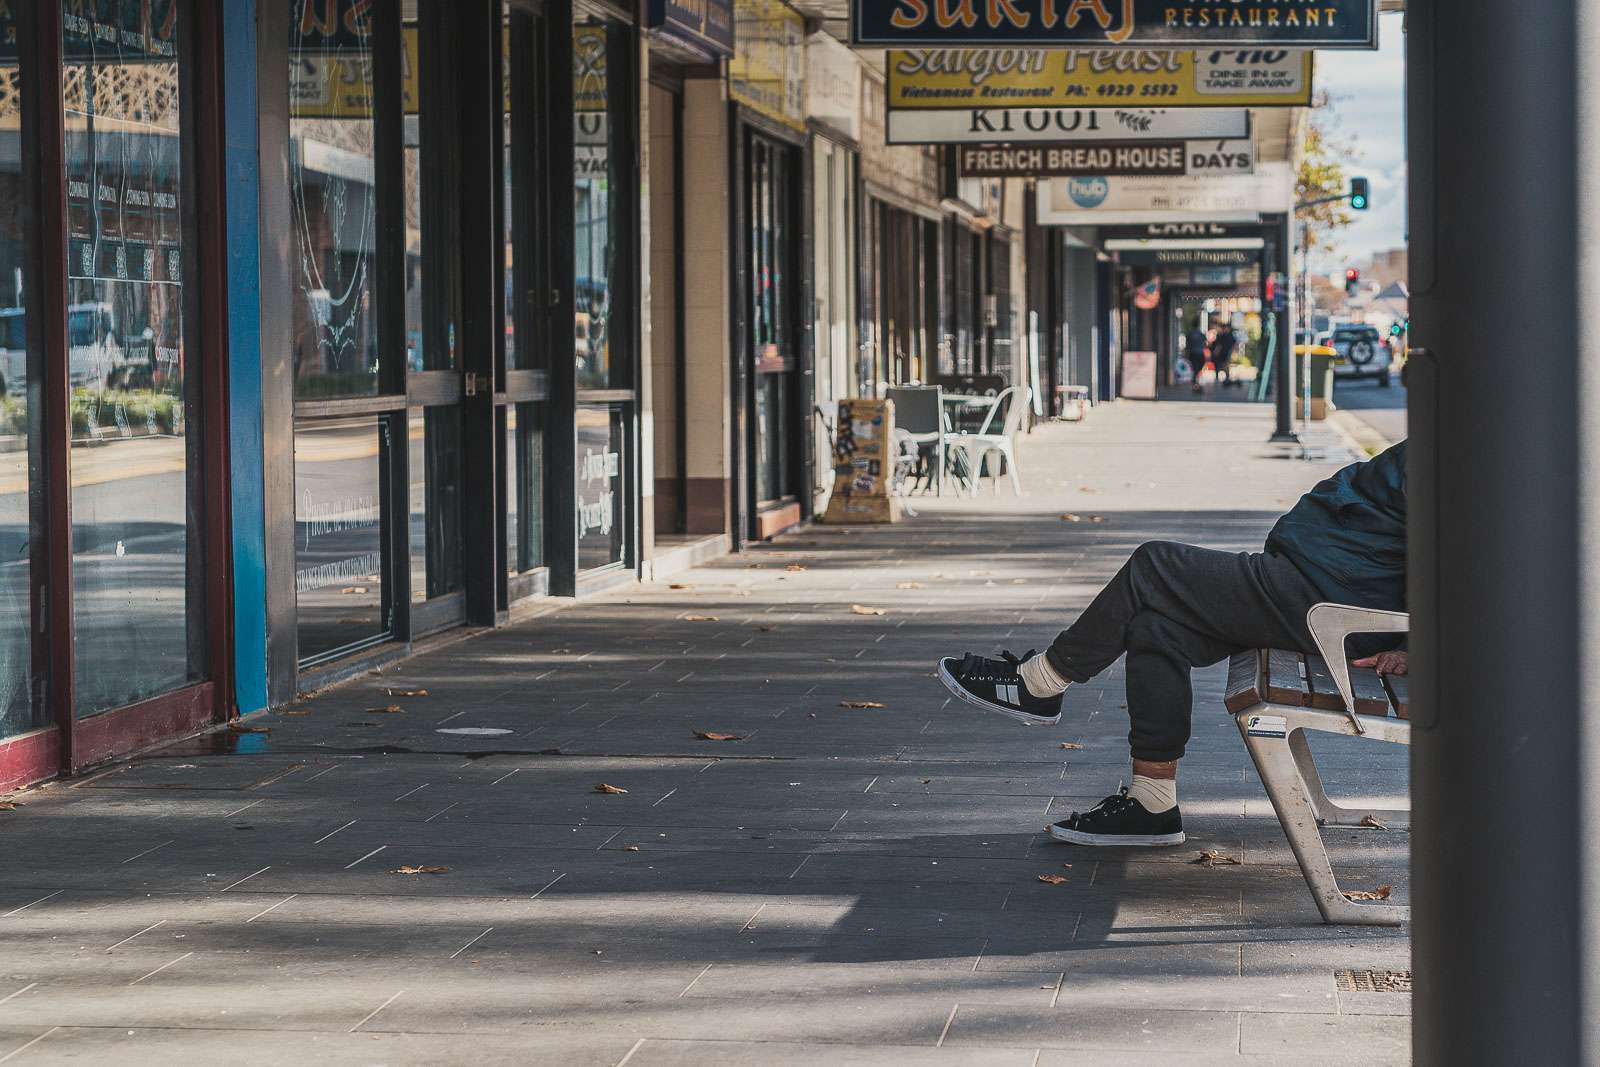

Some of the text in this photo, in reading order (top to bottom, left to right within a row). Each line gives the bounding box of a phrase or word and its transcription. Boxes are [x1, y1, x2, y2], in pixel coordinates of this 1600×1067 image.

[1164, 8, 1337, 27] RESTAURANT
[897, 49, 1047, 84] Saigon
[1209, 70, 1288, 79] DINE IN or
[902, 86, 975, 98] Vietnamese
[980, 86, 1055, 98] Restaurant
[1096, 83, 1135, 96] 4929
[1141, 83, 1179, 96] 5592
[1204, 79, 1295, 88] TAKE AWAY
[965, 148, 1184, 170] FRENCH BREAD HOUSE
[1192, 153, 1250, 169] DAYS
[1071, 178, 1105, 199] hub
